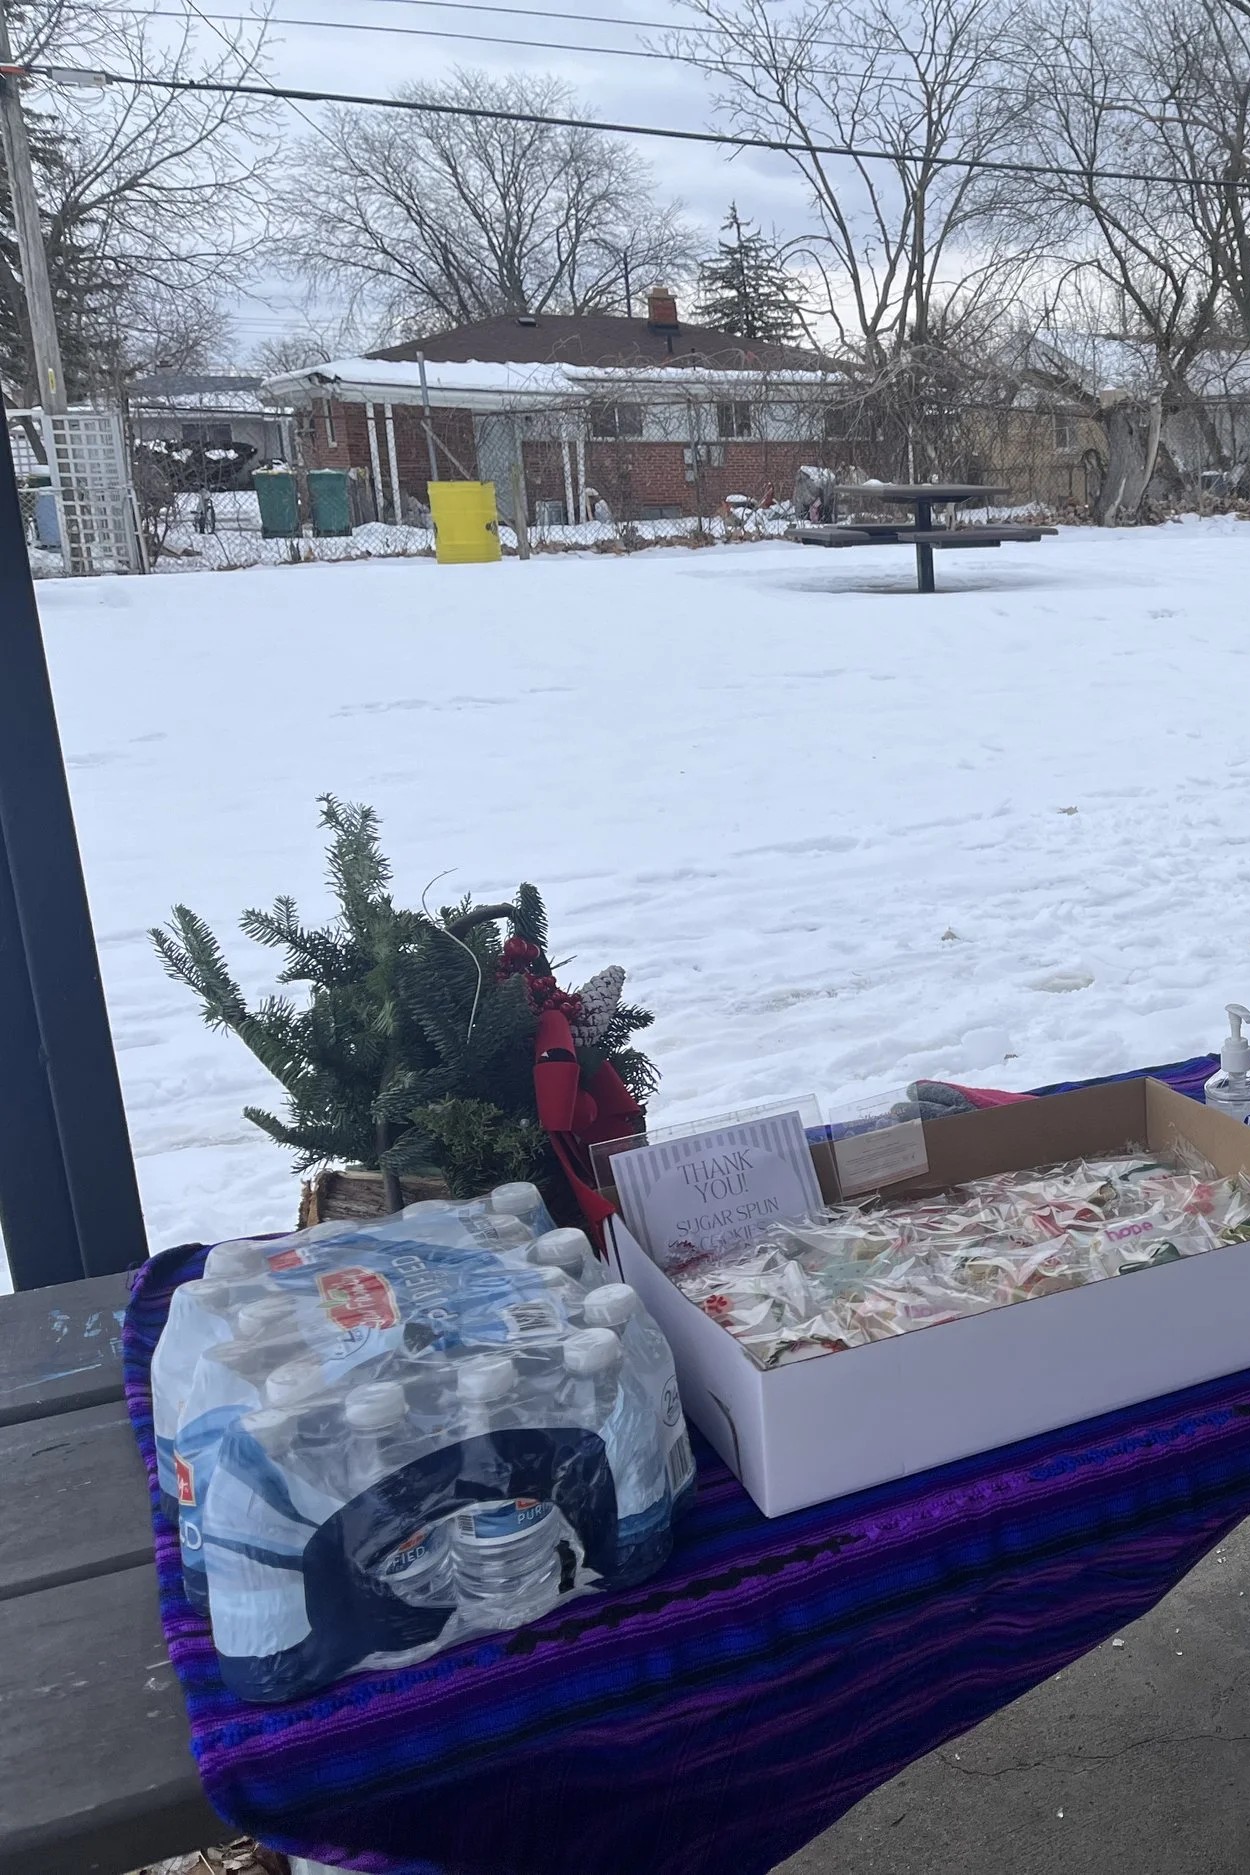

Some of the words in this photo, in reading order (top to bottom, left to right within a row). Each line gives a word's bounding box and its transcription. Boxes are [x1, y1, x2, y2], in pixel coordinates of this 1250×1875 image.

[677, 1149, 754, 1185] THANK
[694, 1172, 748, 1204] YOU!
[676, 1209, 733, 1238] SUGAR
[735, 1197, 779, 1221] SPUN
